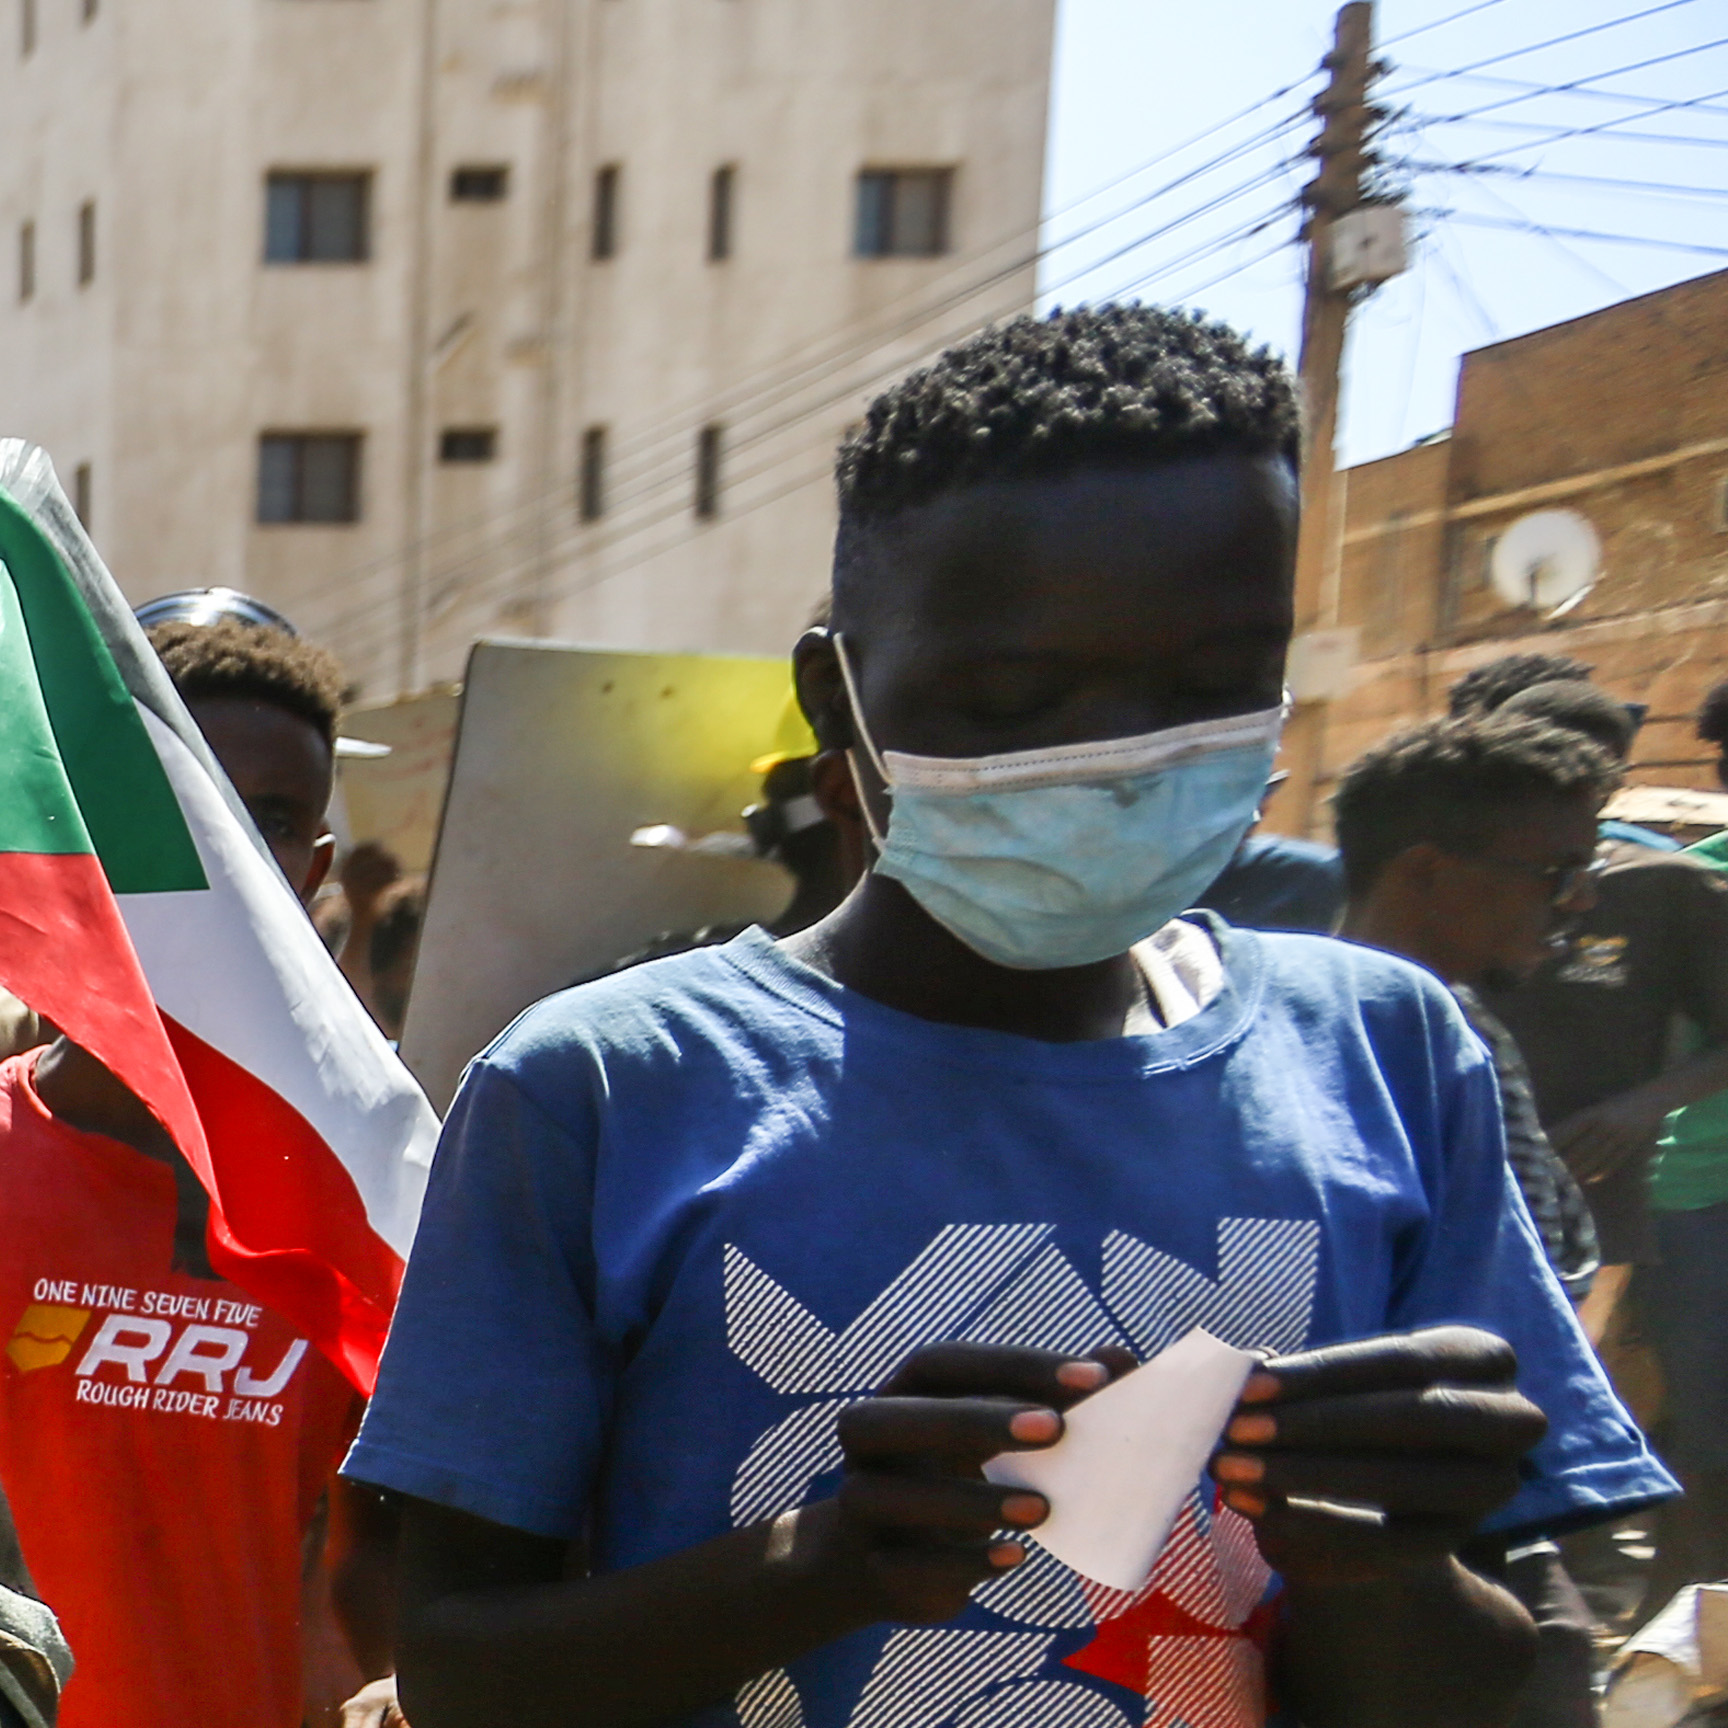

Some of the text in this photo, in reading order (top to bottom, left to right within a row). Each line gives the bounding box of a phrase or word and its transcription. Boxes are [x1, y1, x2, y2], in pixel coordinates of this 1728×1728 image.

[34, 1278, 263, 1328] ONE NINE SEVEN FIVE
[75, 1313, 310, 1397] RRJ
[76, 1379, 284, 1427] ROUGH RIDER JEANS
